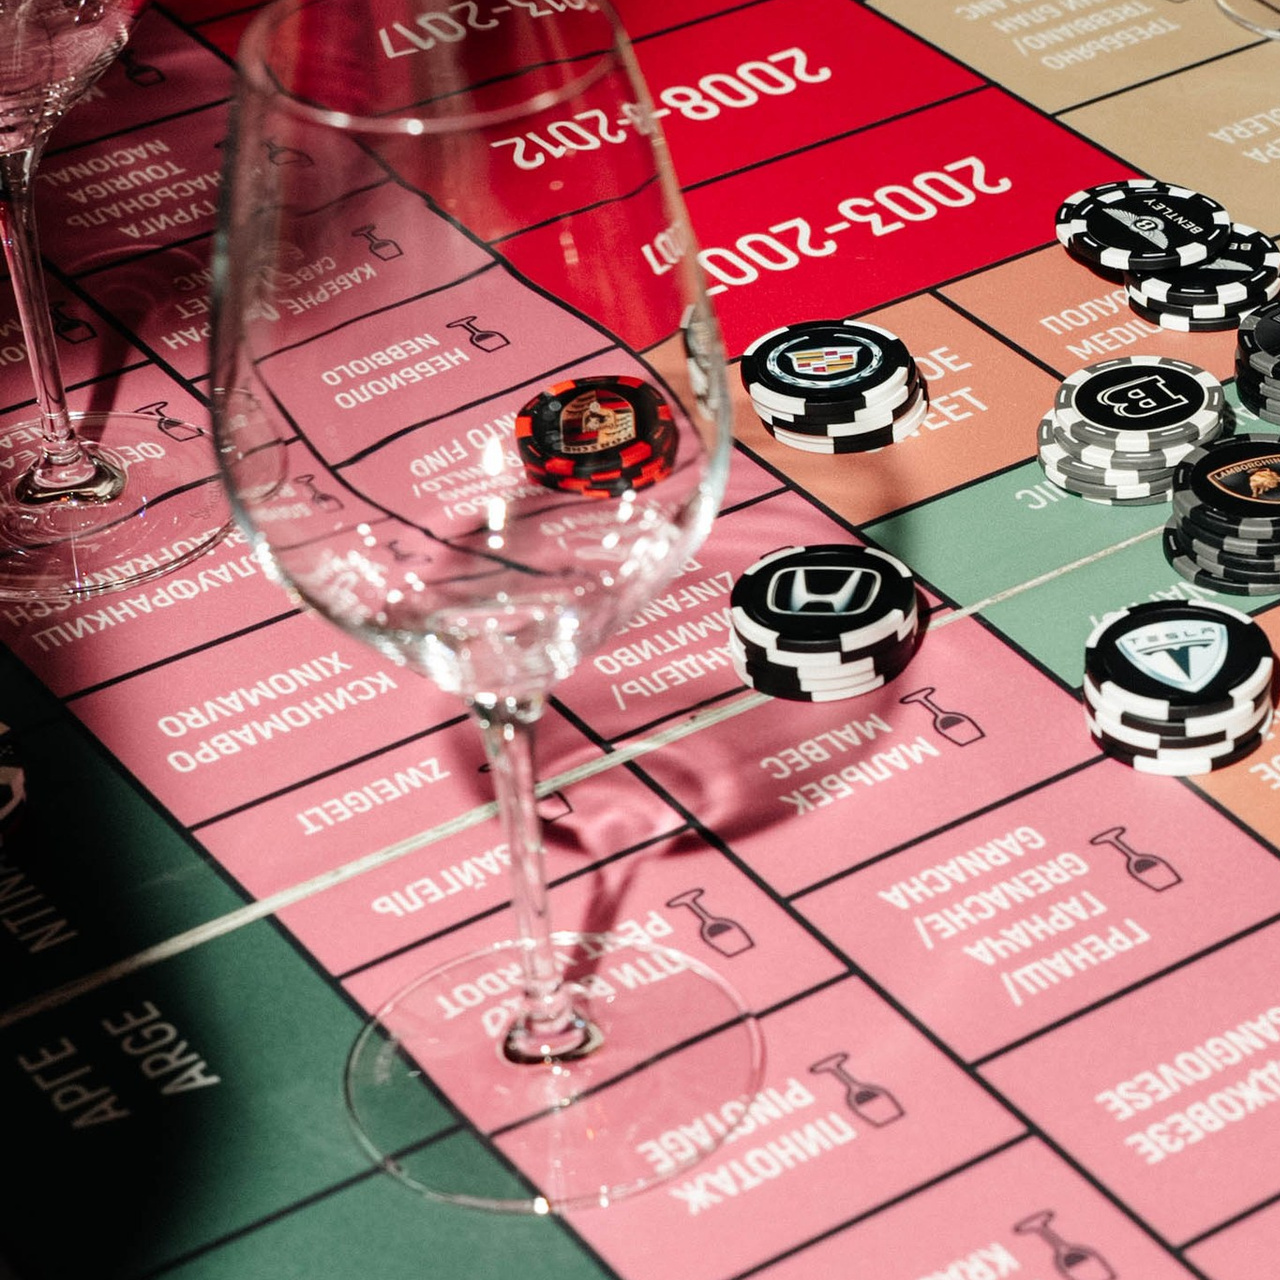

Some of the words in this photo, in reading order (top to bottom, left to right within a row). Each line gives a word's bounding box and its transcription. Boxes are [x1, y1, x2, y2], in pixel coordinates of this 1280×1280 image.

[990, 6, 1058, 35] БЛАН
[1012, 0, 1155, 56] TREBBIANO/
[1040, 16, 1181, 71] ТРЕББЬЯНО
[37, 139, 171, 187] NACIONAL
[67, 160, 187, 205] TOURIGA
[66, 171, 224, 228] НАСЬОНАЛЬ
[118, 199, 220, 240] ТУРИГА
[1142, 197, 1204, 235] BENTLEY
[277, 262, 378, 316] КАБЕРНЕ
[320, 332, 441, 388] NEBBIOLO
[334, 347, 471, 410] НЕББИОЛО
[410, 439, 469, 478] FINO
[1130, 624, 1217, 647] TESLA
[157, 650, 353, 739] XINOMAVRO
[166, 670, 398, 774] КСИНОМАВРО
[759, 713, 893, 779] MALBEC
[779, 736, 940, 816] МАЛЬБЕК
[296, 757, 451, 836] ZWEIGELT
[371, 842, 516, 918] ВАЙГЕЛЬ
[877, 826, 1047, 910] GARNACHA
[913, 852, 1090, 950] GRENACHE/
[962, 890, 1108, 966] ГАРНАЧА
[998, 918, 1151, 1008] ГРЕНАШ/
[101, 1000, 222, 1097] ARGE
[635, 1078, 816, 1176] PINOTAGE
[670, 1113, 857, 1215] ПИНОТАЖ
